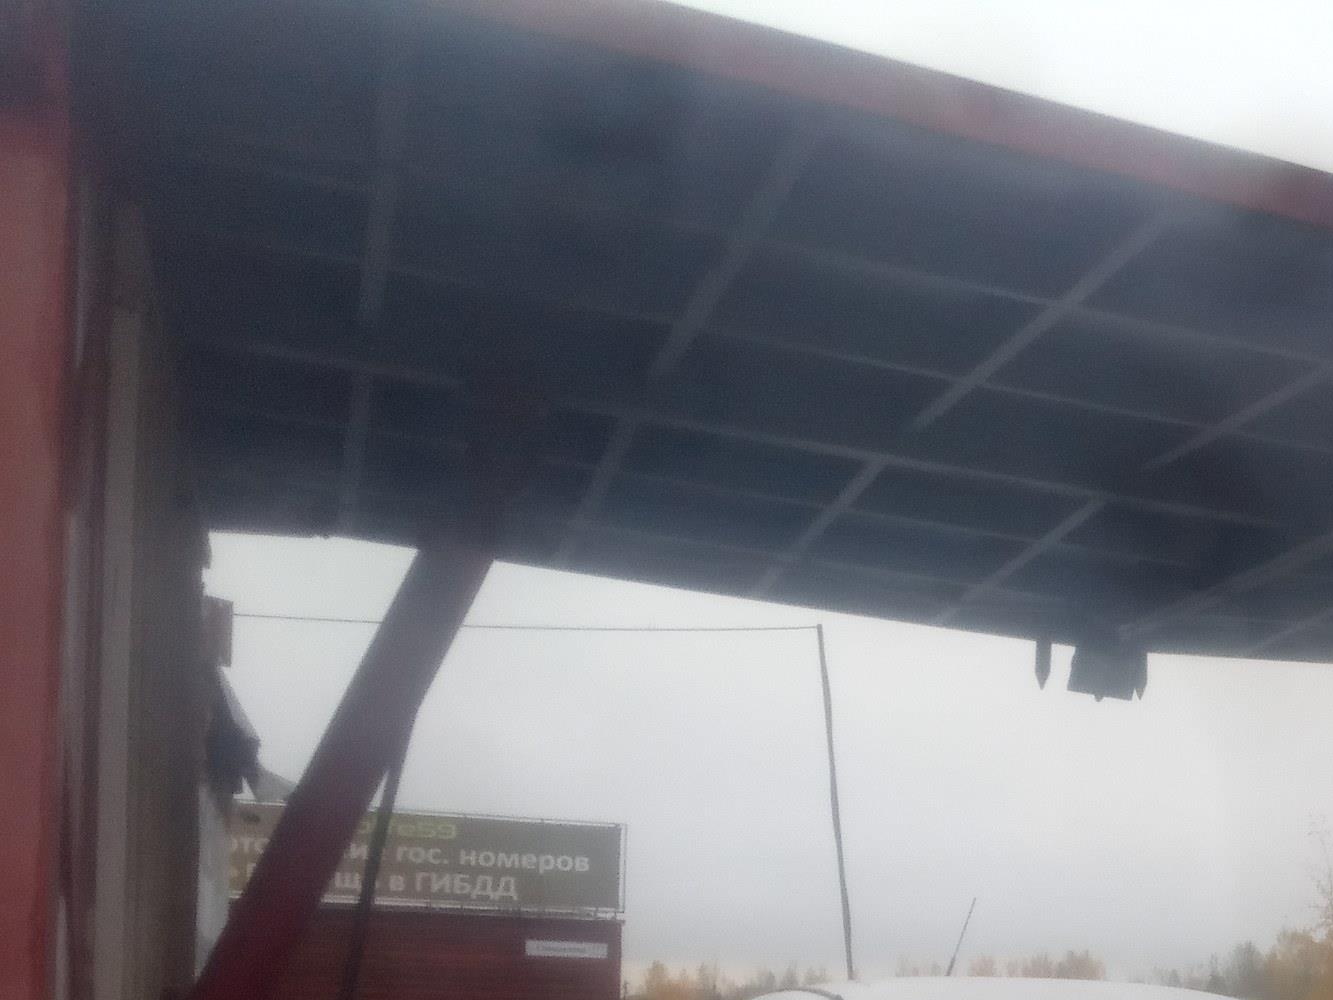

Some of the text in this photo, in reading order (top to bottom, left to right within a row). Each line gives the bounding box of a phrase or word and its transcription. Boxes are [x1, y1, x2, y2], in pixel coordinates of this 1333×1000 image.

[396, 846, 449, 865] гос.
[459, 848, 590, 873] номеров
[389, 875, 405, 891] в
[415, 871, 519, 901] ГИБДД
